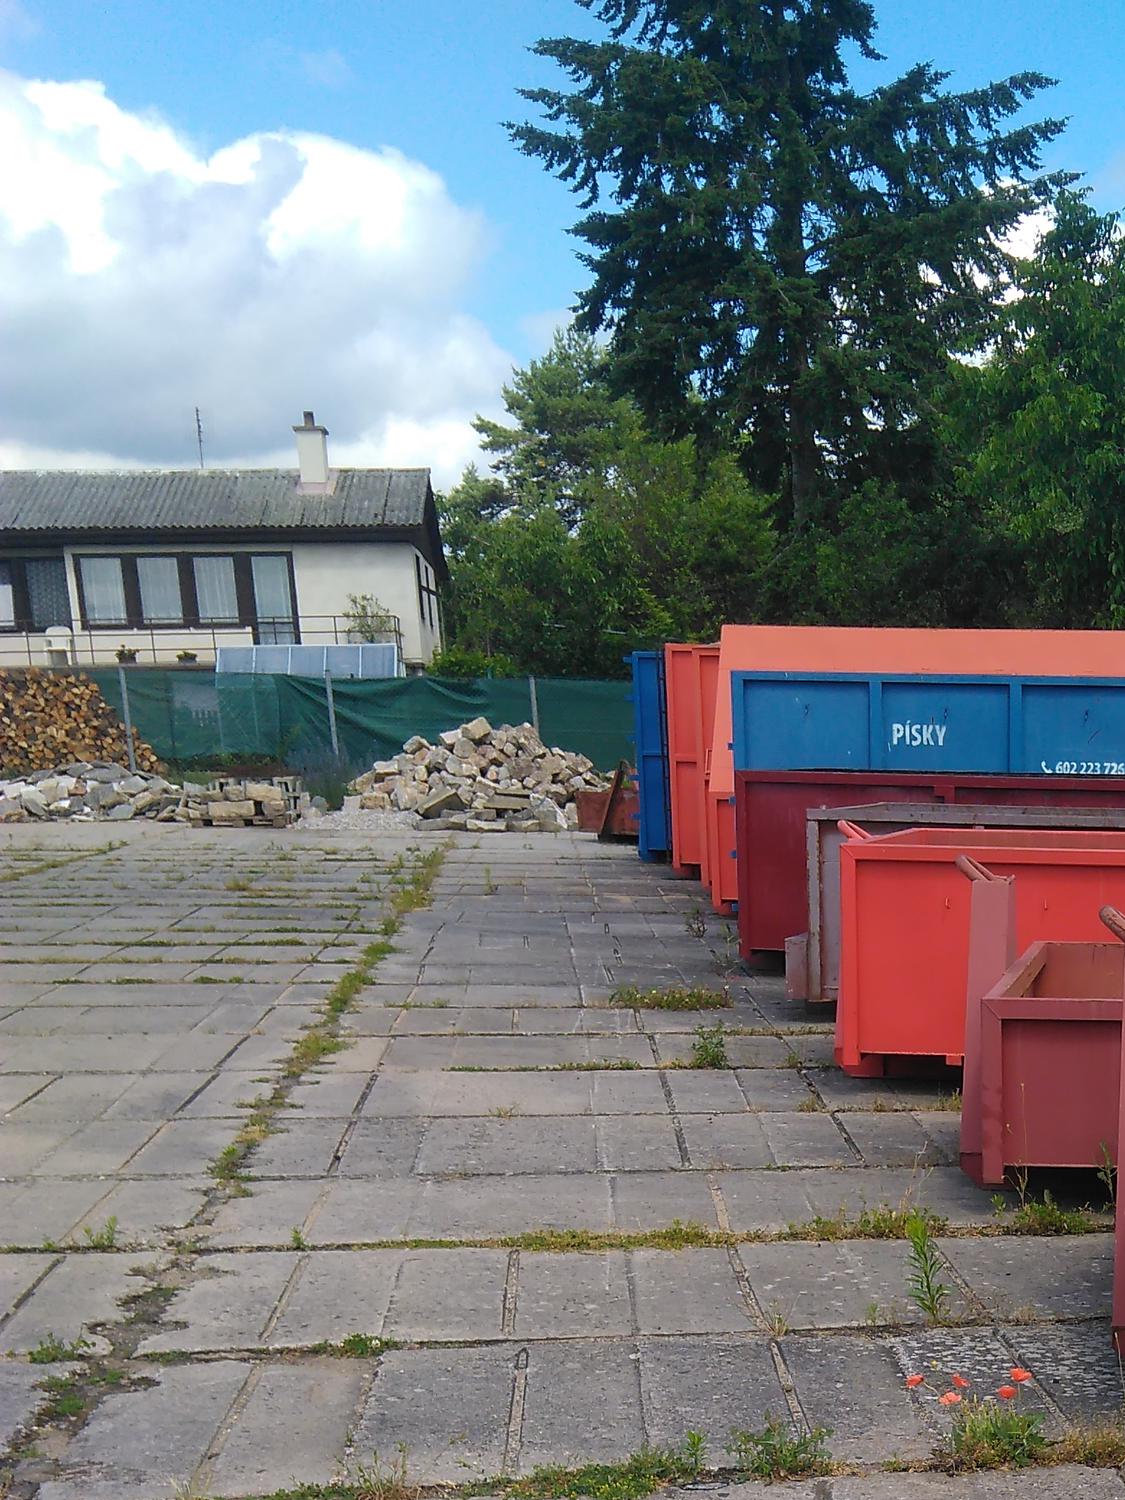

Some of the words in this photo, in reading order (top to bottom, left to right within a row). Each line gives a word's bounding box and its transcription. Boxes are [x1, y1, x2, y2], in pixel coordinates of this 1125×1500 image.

[892, 720, 947, 747] PÍSKY
[1055, 761, 1078, 774] 602
[1079, 762, 1101, 775] 223
[1103, 762, 1125, 775] 726
